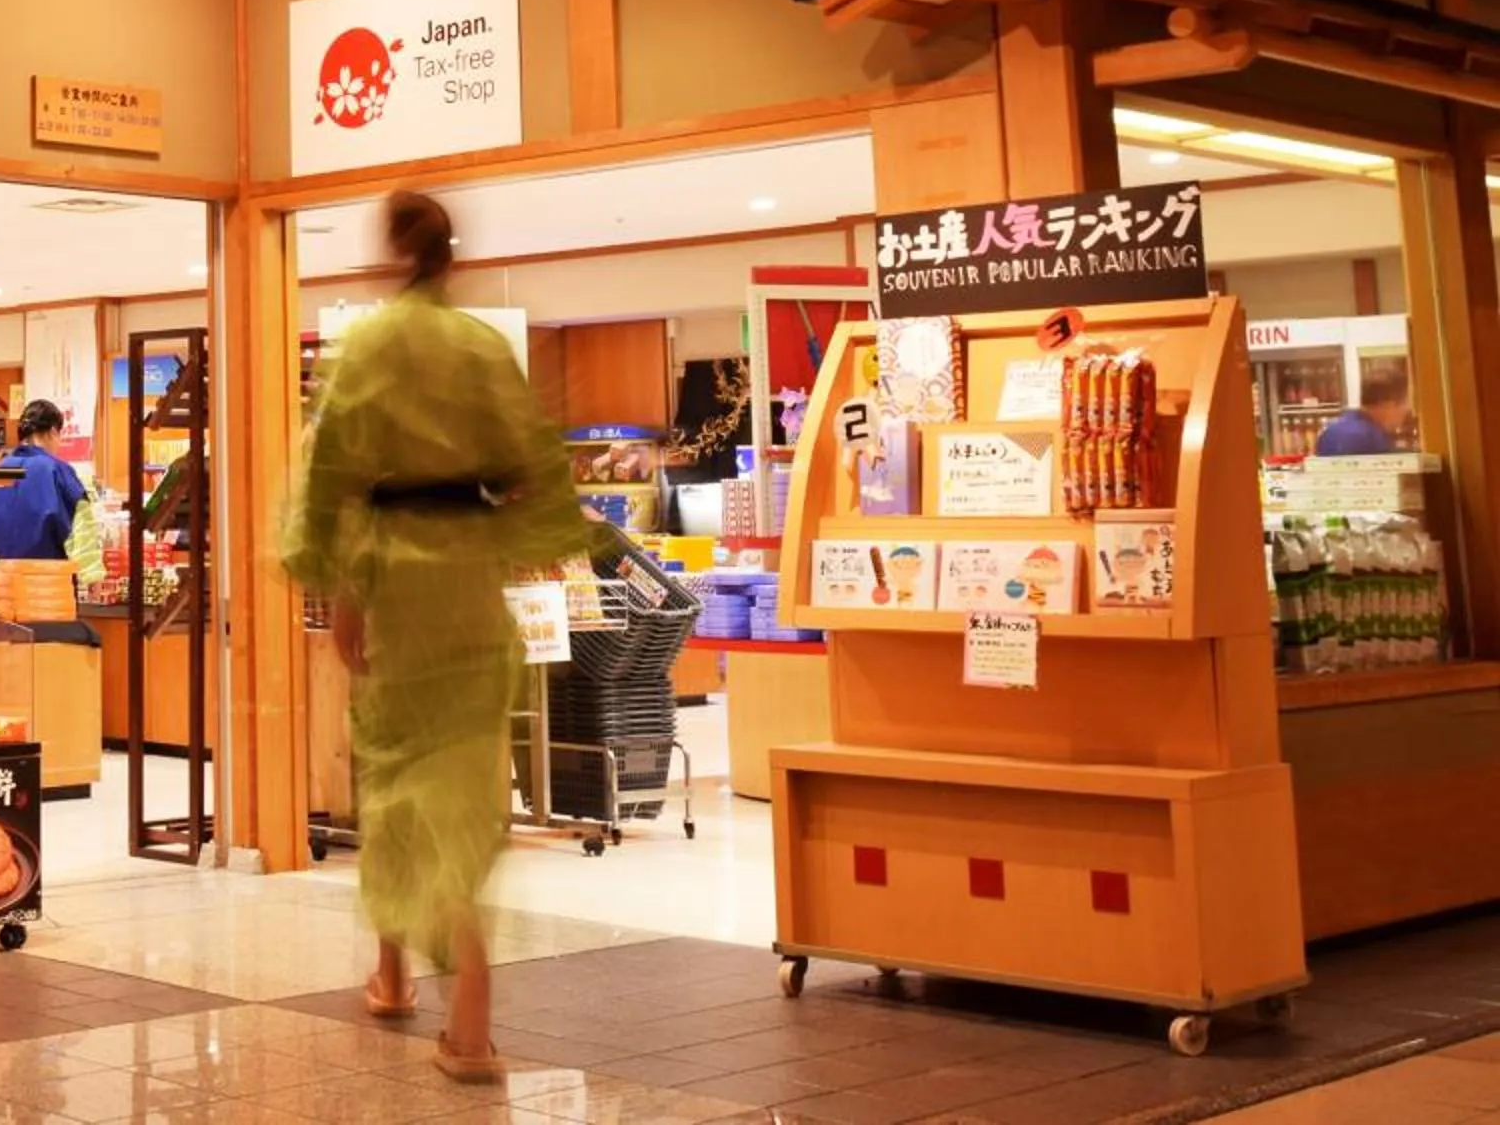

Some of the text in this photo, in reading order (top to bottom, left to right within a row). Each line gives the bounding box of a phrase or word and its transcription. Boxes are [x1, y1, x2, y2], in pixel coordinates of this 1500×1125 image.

[421, 15, 493, 45] Japan.
[414, 47, 495, 79] Tax-free
[444, 78, 495, 104] Shop
[877, 185, 1200, 268] お土産人気ランキング
[883, 244, 1198, 294] SOUVENIR POPULAR RANKING
[843, 403, 869, 442] 2
